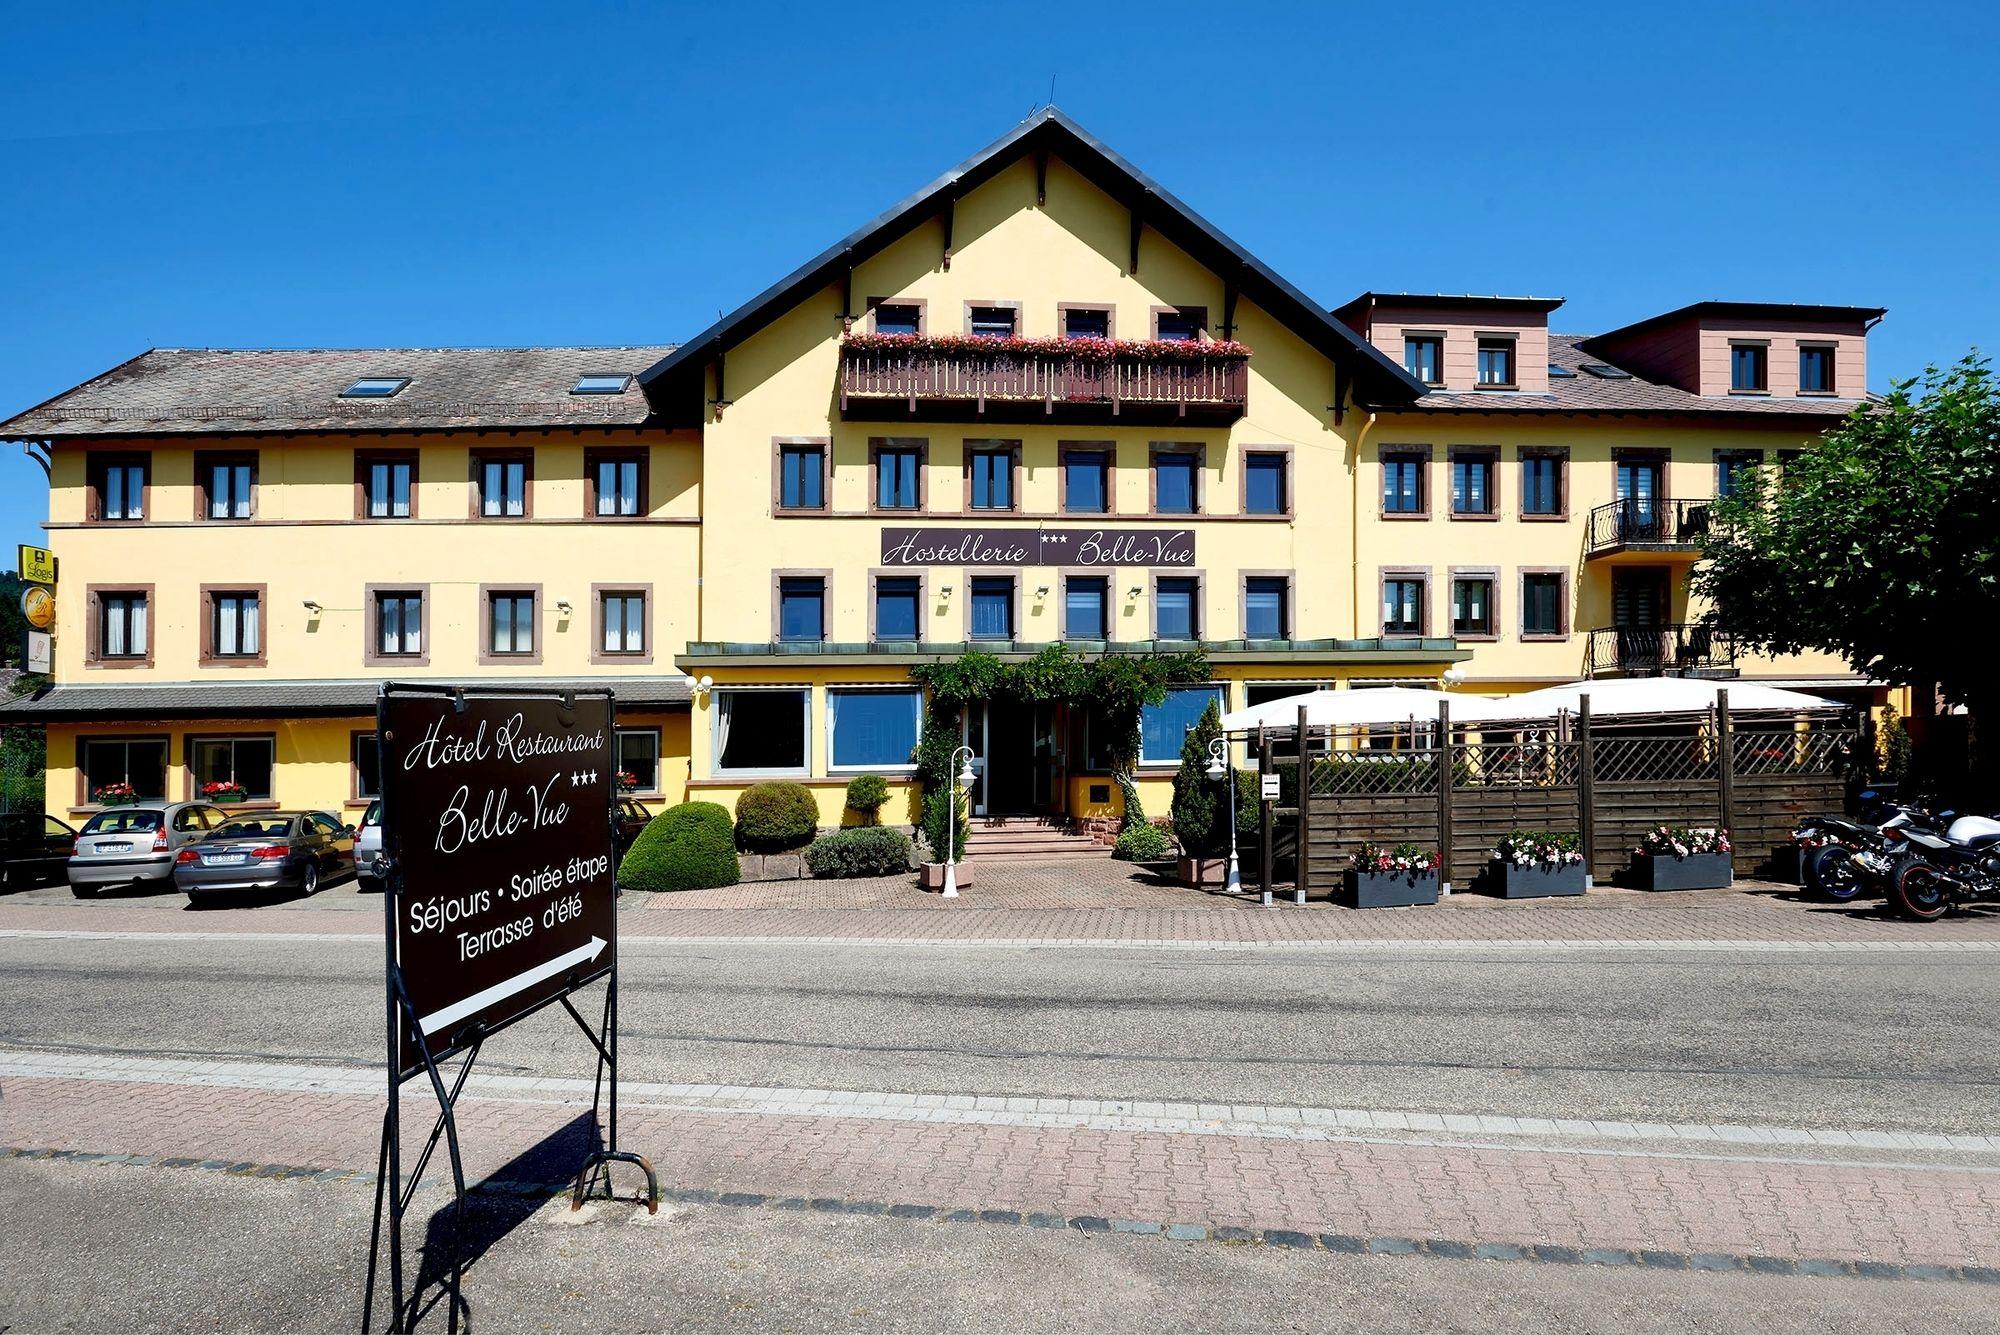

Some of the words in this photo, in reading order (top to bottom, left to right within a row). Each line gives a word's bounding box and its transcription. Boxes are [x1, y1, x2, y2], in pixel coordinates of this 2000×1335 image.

[27, 562, 53, 581] Logis
[882, 529, 1029, 564] Hostellerie
[1075, 531, 1194, 565] Belle-Vue
[404, 714, 491, 771] Hôtel
[496, 712, 605, 764] Restaurant
[434, 772, 570, 854] Belle-Vue
[410, 890, 490, 934] Séjours
[511, 864, 563, 902] Soirée
[566, 855, 608, 884] étape
[456, 916, 534, 962] Terrasse
[543, 891, 583, 929] d'été
